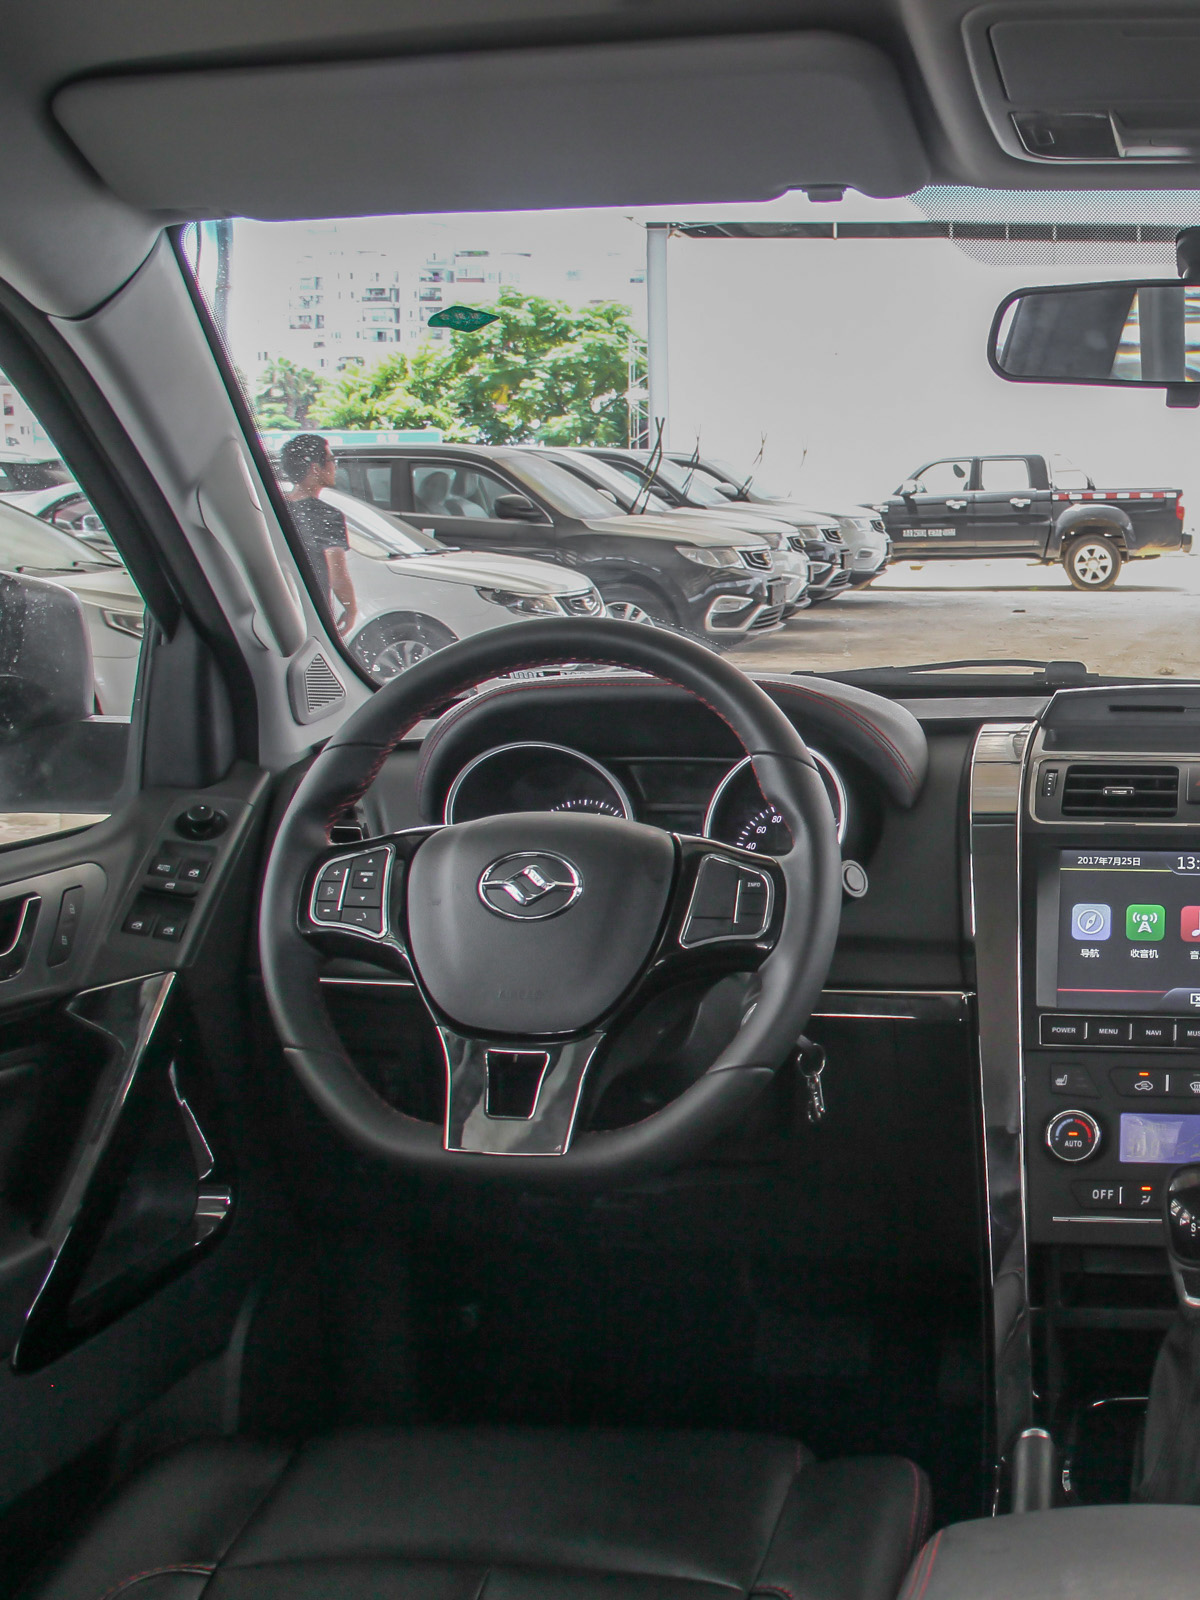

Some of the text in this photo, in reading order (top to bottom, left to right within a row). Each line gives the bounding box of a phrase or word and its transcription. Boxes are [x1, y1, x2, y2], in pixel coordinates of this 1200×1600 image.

[771, 815, 782, 823] 80
[756, 826, 767, 834] 60
[745, 842, 756, 850] 40
[1077, 856, 1141, 866] 2017年7月25日
[1080, 948, 1100, 958] 导航
[1130, 949, 1159, 959] 收音机
[1051, 1026, 1076, 1034] POWER
[1064, 1140, 1083, 1148] AUTO
[1092, 1189, 1114, 1200] OFF
